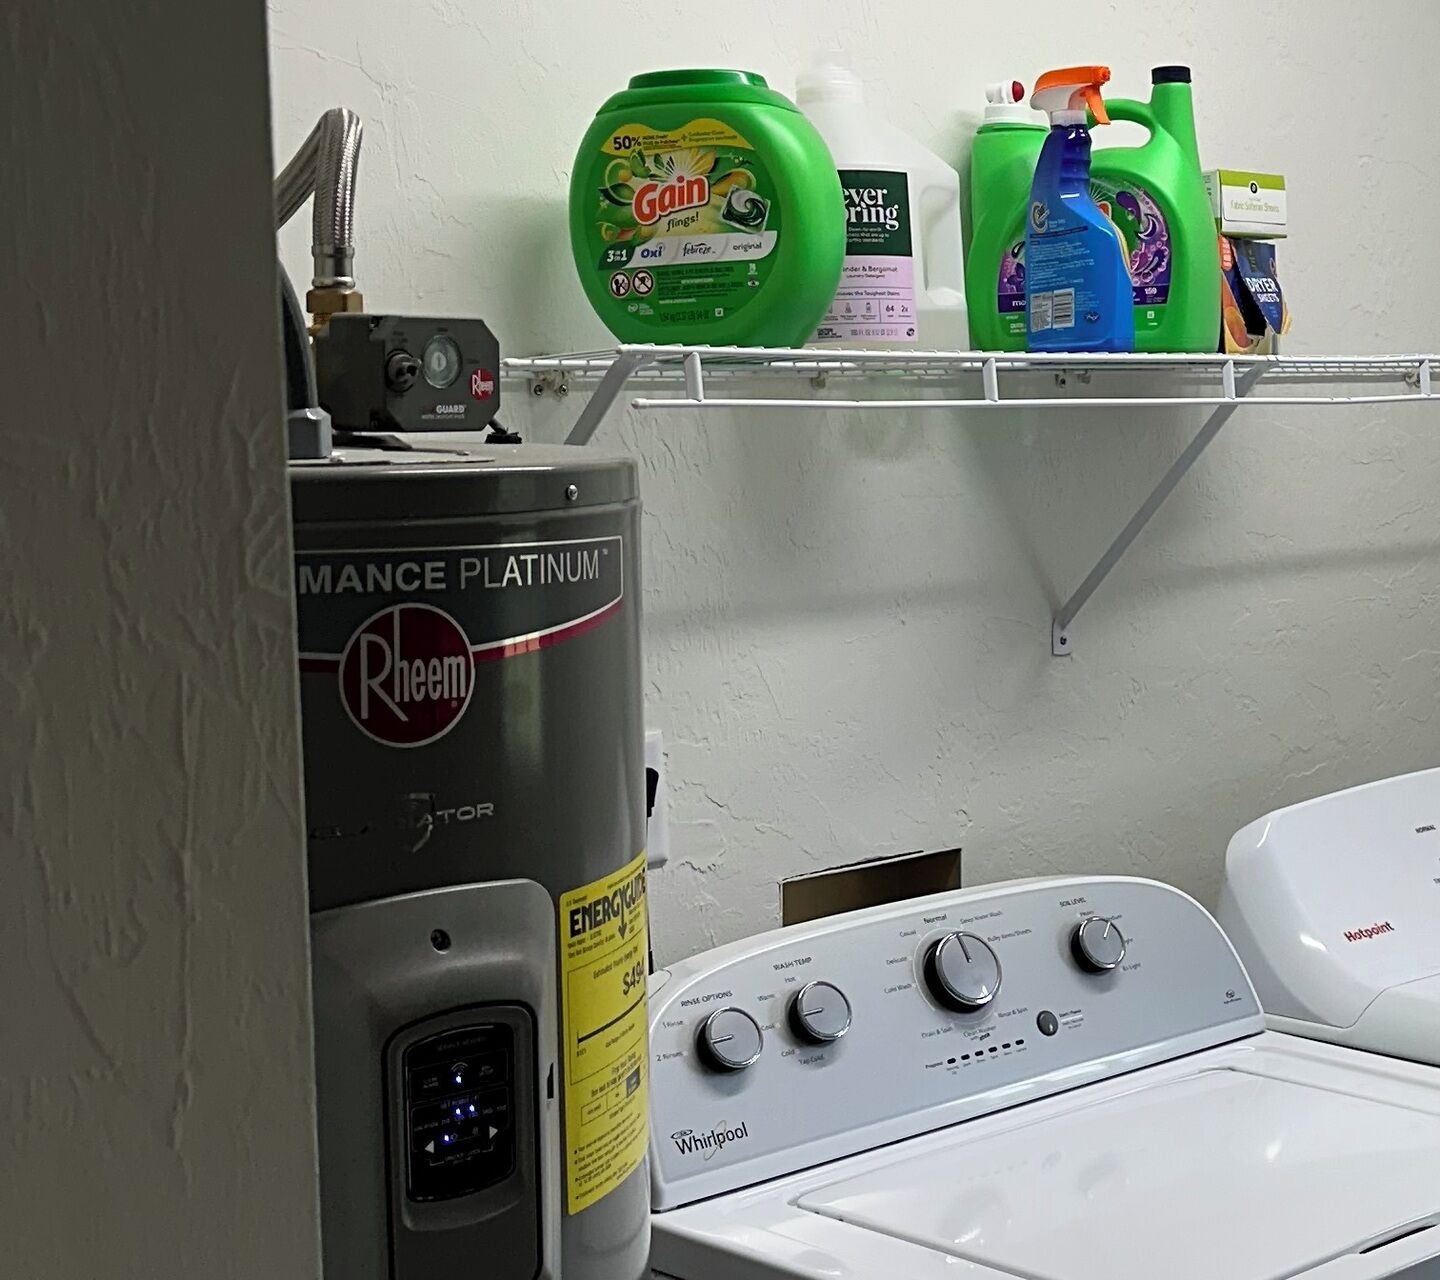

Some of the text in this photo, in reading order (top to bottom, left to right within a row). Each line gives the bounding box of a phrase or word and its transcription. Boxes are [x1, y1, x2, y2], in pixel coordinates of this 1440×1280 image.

[613, 136, 641, 151] 50%
[633, 175, 707, 224] Gain
[733, 242, 763, 252] original
[1248, 277, 1278, 293] DRYER
[1257, 293, 1280, 303] SHEETS
[436, 404, 465, 414] GUARD
[300, 550, 600, 595] MANCE PLATINUM
[360, 608, 467, 721] Rheem
[923, 914, 947, 924] Normal
[1344, 921, 1394, 943] Hotpoint
[702, 990, 733, 1003] OPTIONS
[656, 1054, 662, 1062] 2
[781, 1049, 796, 1058] Cold
[674, 1121, 748, 1155] Whirlpool
